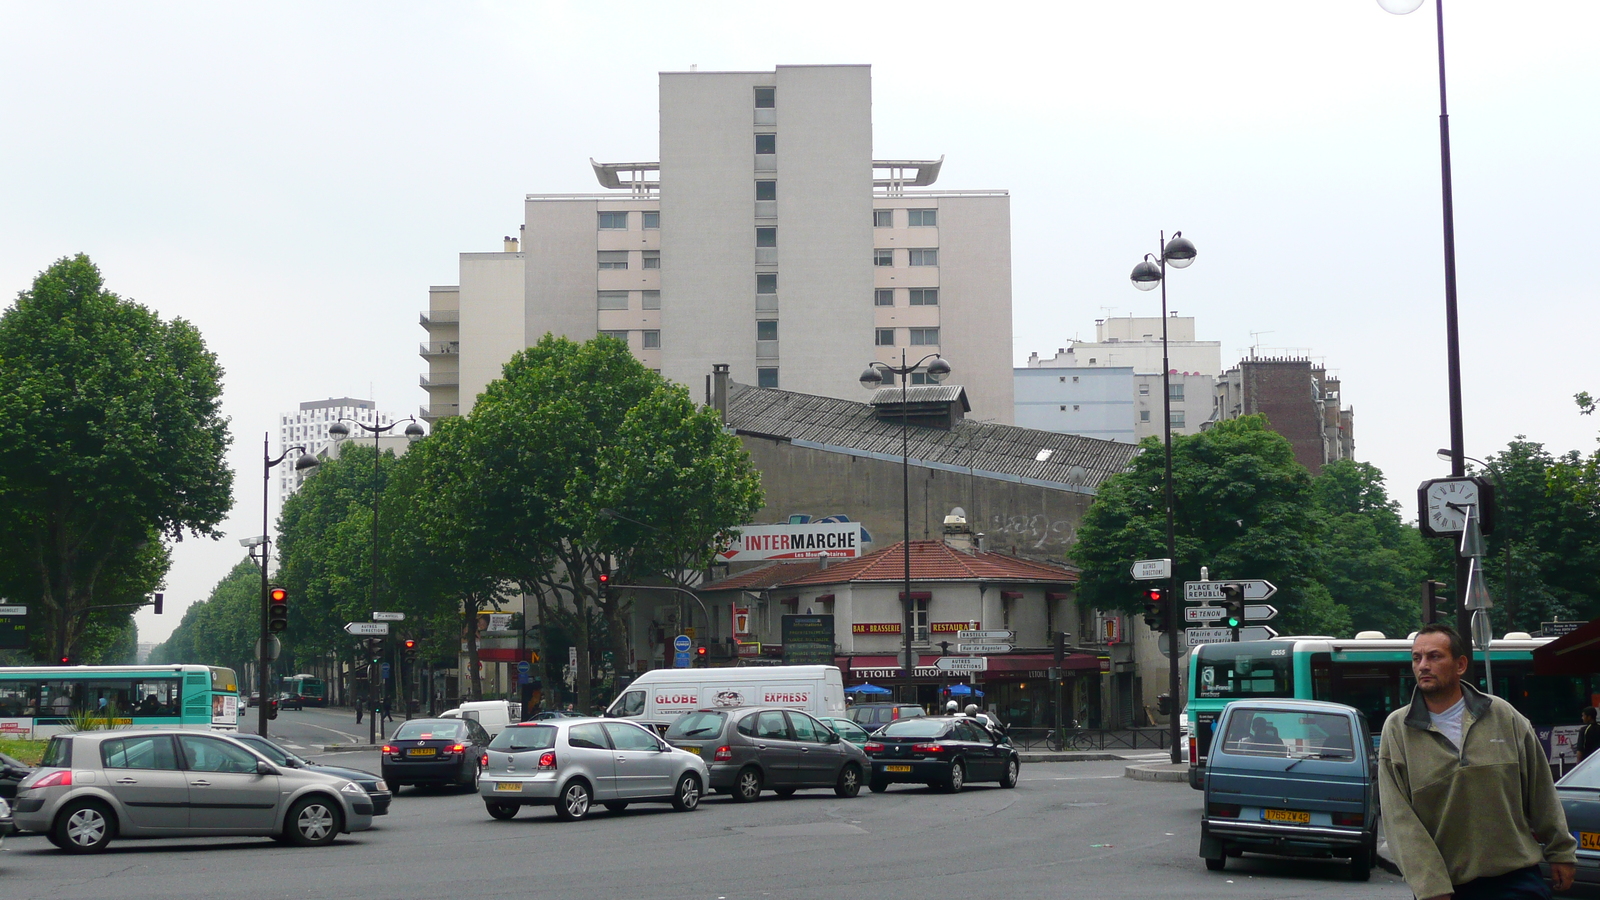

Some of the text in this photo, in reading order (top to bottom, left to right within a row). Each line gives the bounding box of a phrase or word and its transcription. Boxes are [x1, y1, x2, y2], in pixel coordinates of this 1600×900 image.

[853, 624, 865, 632] BAR
[869, 624, 901, 632] BRASSERIE
[933, 622, 977, 632] RESTAURAT
[856, 669, 897, 678] L'ETOILE
[655, 692, 808, 704] GLOBE EXPRESS
[1267, 811, 1308, 821] 1765 ZW 42
